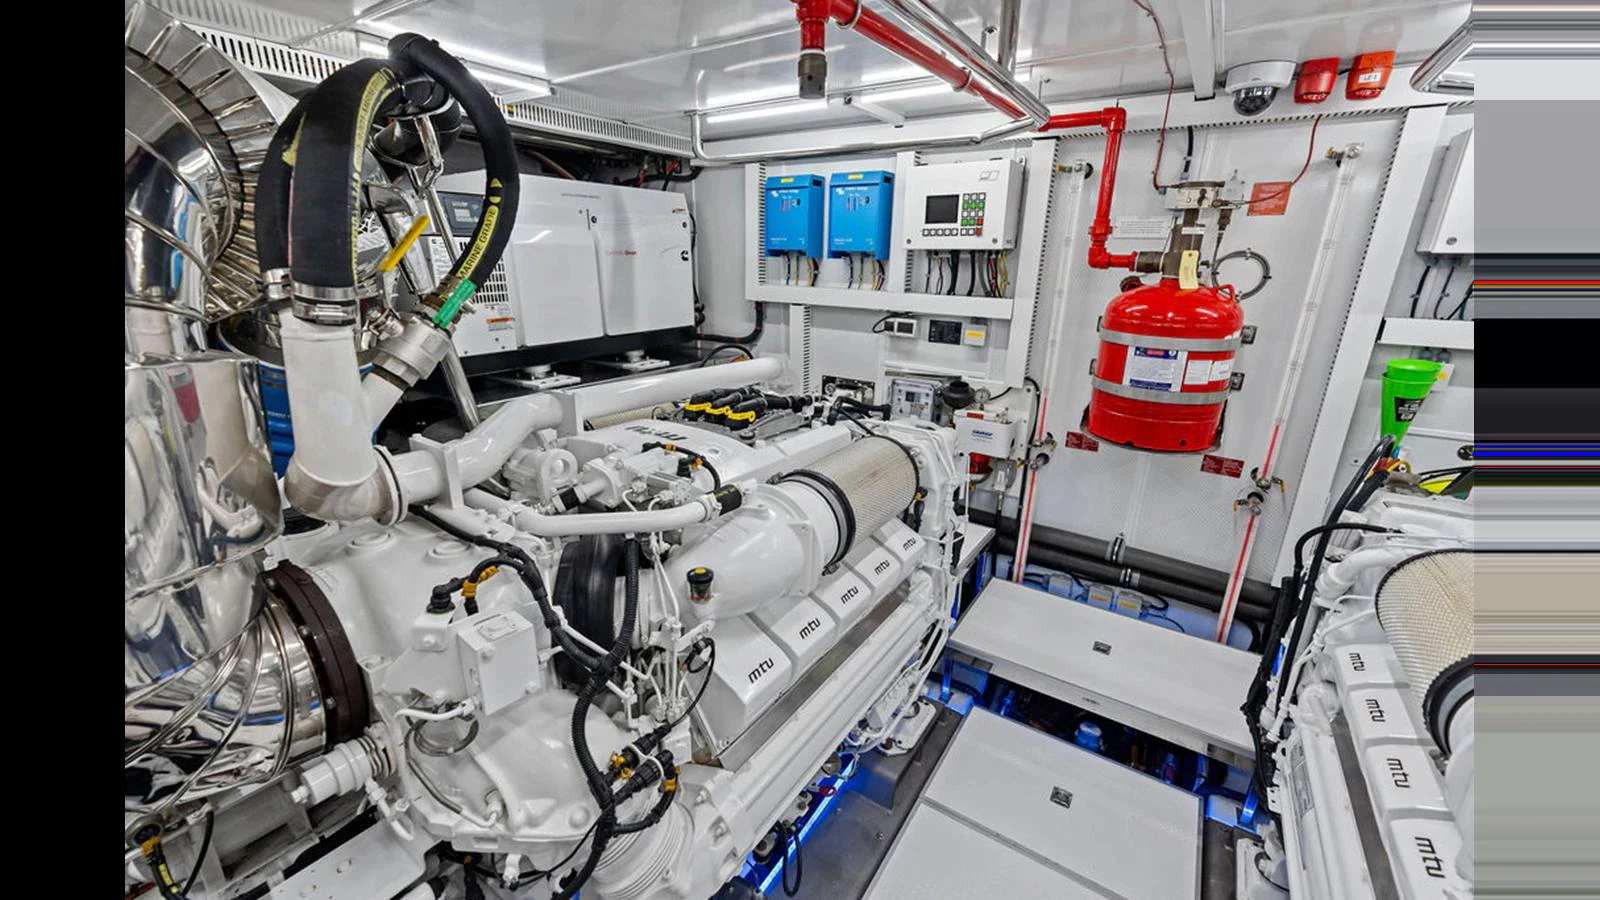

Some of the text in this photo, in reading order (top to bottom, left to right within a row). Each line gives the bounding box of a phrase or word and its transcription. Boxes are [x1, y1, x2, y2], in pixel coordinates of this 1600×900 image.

[902, 536, 917, 551] mtu
[874, 559, 890, 575] mtu
[840, 585, 859, 604] mtu
[799, 617, 821, 639] mtu
[748, 658, 774, 684] mtu
[1349, 652, 1365, 672] mtu
[1365, 698, 1386, 722] mtu
[1386, 757, 1411, 788] mtu
[1414, 836, 1446, 879] mtu
